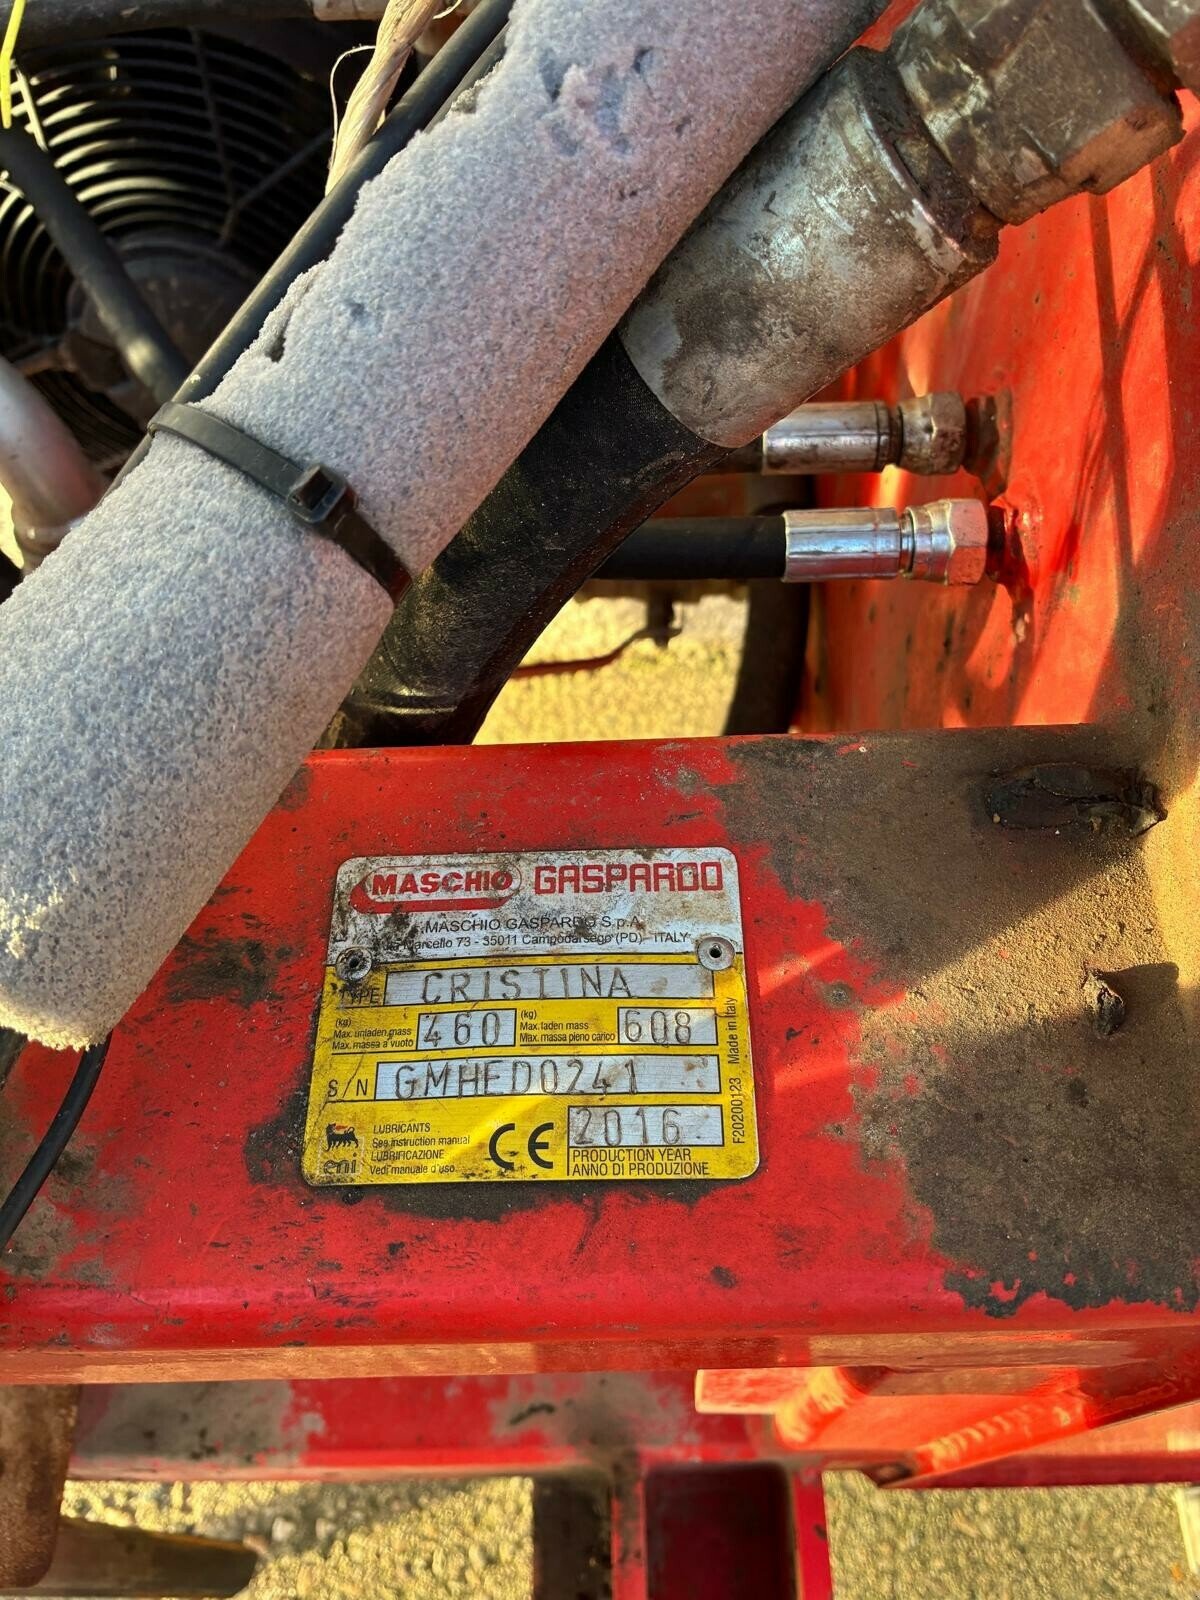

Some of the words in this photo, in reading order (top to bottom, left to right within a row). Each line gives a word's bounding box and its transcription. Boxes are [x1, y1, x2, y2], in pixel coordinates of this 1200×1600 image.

[371, 870, 513, 895] MASCHIO
[534, 861, 724, 895] GASPARDO
[425, 919, 500, 934] MASCHIO
[457, 936, 471, 947] 73
[483, 934, 517, 946] 35011
[616, 932, 642, 945] (PD)
[654, 932, 689, 943] ITALY
[422, 965, 632, 1004] CRISTINA
[724, 996, 738, 1018] Italy
[520, 1010, 537, 1020] (kg)
[423, 1012, 501, 1048] 460
[519, 1022, 540, 1030] Max.
[566, 1022, 589, 1030] mass
[624, 1010, 692, 1044] 608
[725, 1021, 738, 1031] in
[333, 1030, 353, 1039] Max.
[519, 1033, 540, 1042] Max.
[541, 1033, 567, 1042] massa
[569, 1032, 590, 1043] pieno
[592, 1032, 616, 1041] carico
[332, 1041, 352, 1050] Max.
[353, 1041, 380, 1049] massa
[390, 1038, 414, 1047] vuoto
[726, 1033, 740, 1064] Made
[394, 1058, 638, 1099] GMHED0241
[729, 1077, 745, 1144] F20200123
[373, 1122, 431, 1134] LUBRICANTS
[573, 1107, 682, 1147] 2016
[372, 1138, 389, 1149] See
[390, 1136, 436, 1148] instruction
[438, 1135, 470, 1145] manual
[371, 1149, 445, 1161] LUBRIFICAZIONE
[572, 1148, 655, 1162] PRODUCTION
[659, 1148, 692, 1161] YEAR
[370, 1165, 389, 1175] Vedi
[391, 1164, 428, 1175] manuale
[572, 1163, 608, 1176] ANNO
[612, 1163, 625, 1176] DI
[628, 1161, 711, 1175] PRODUZIONE
